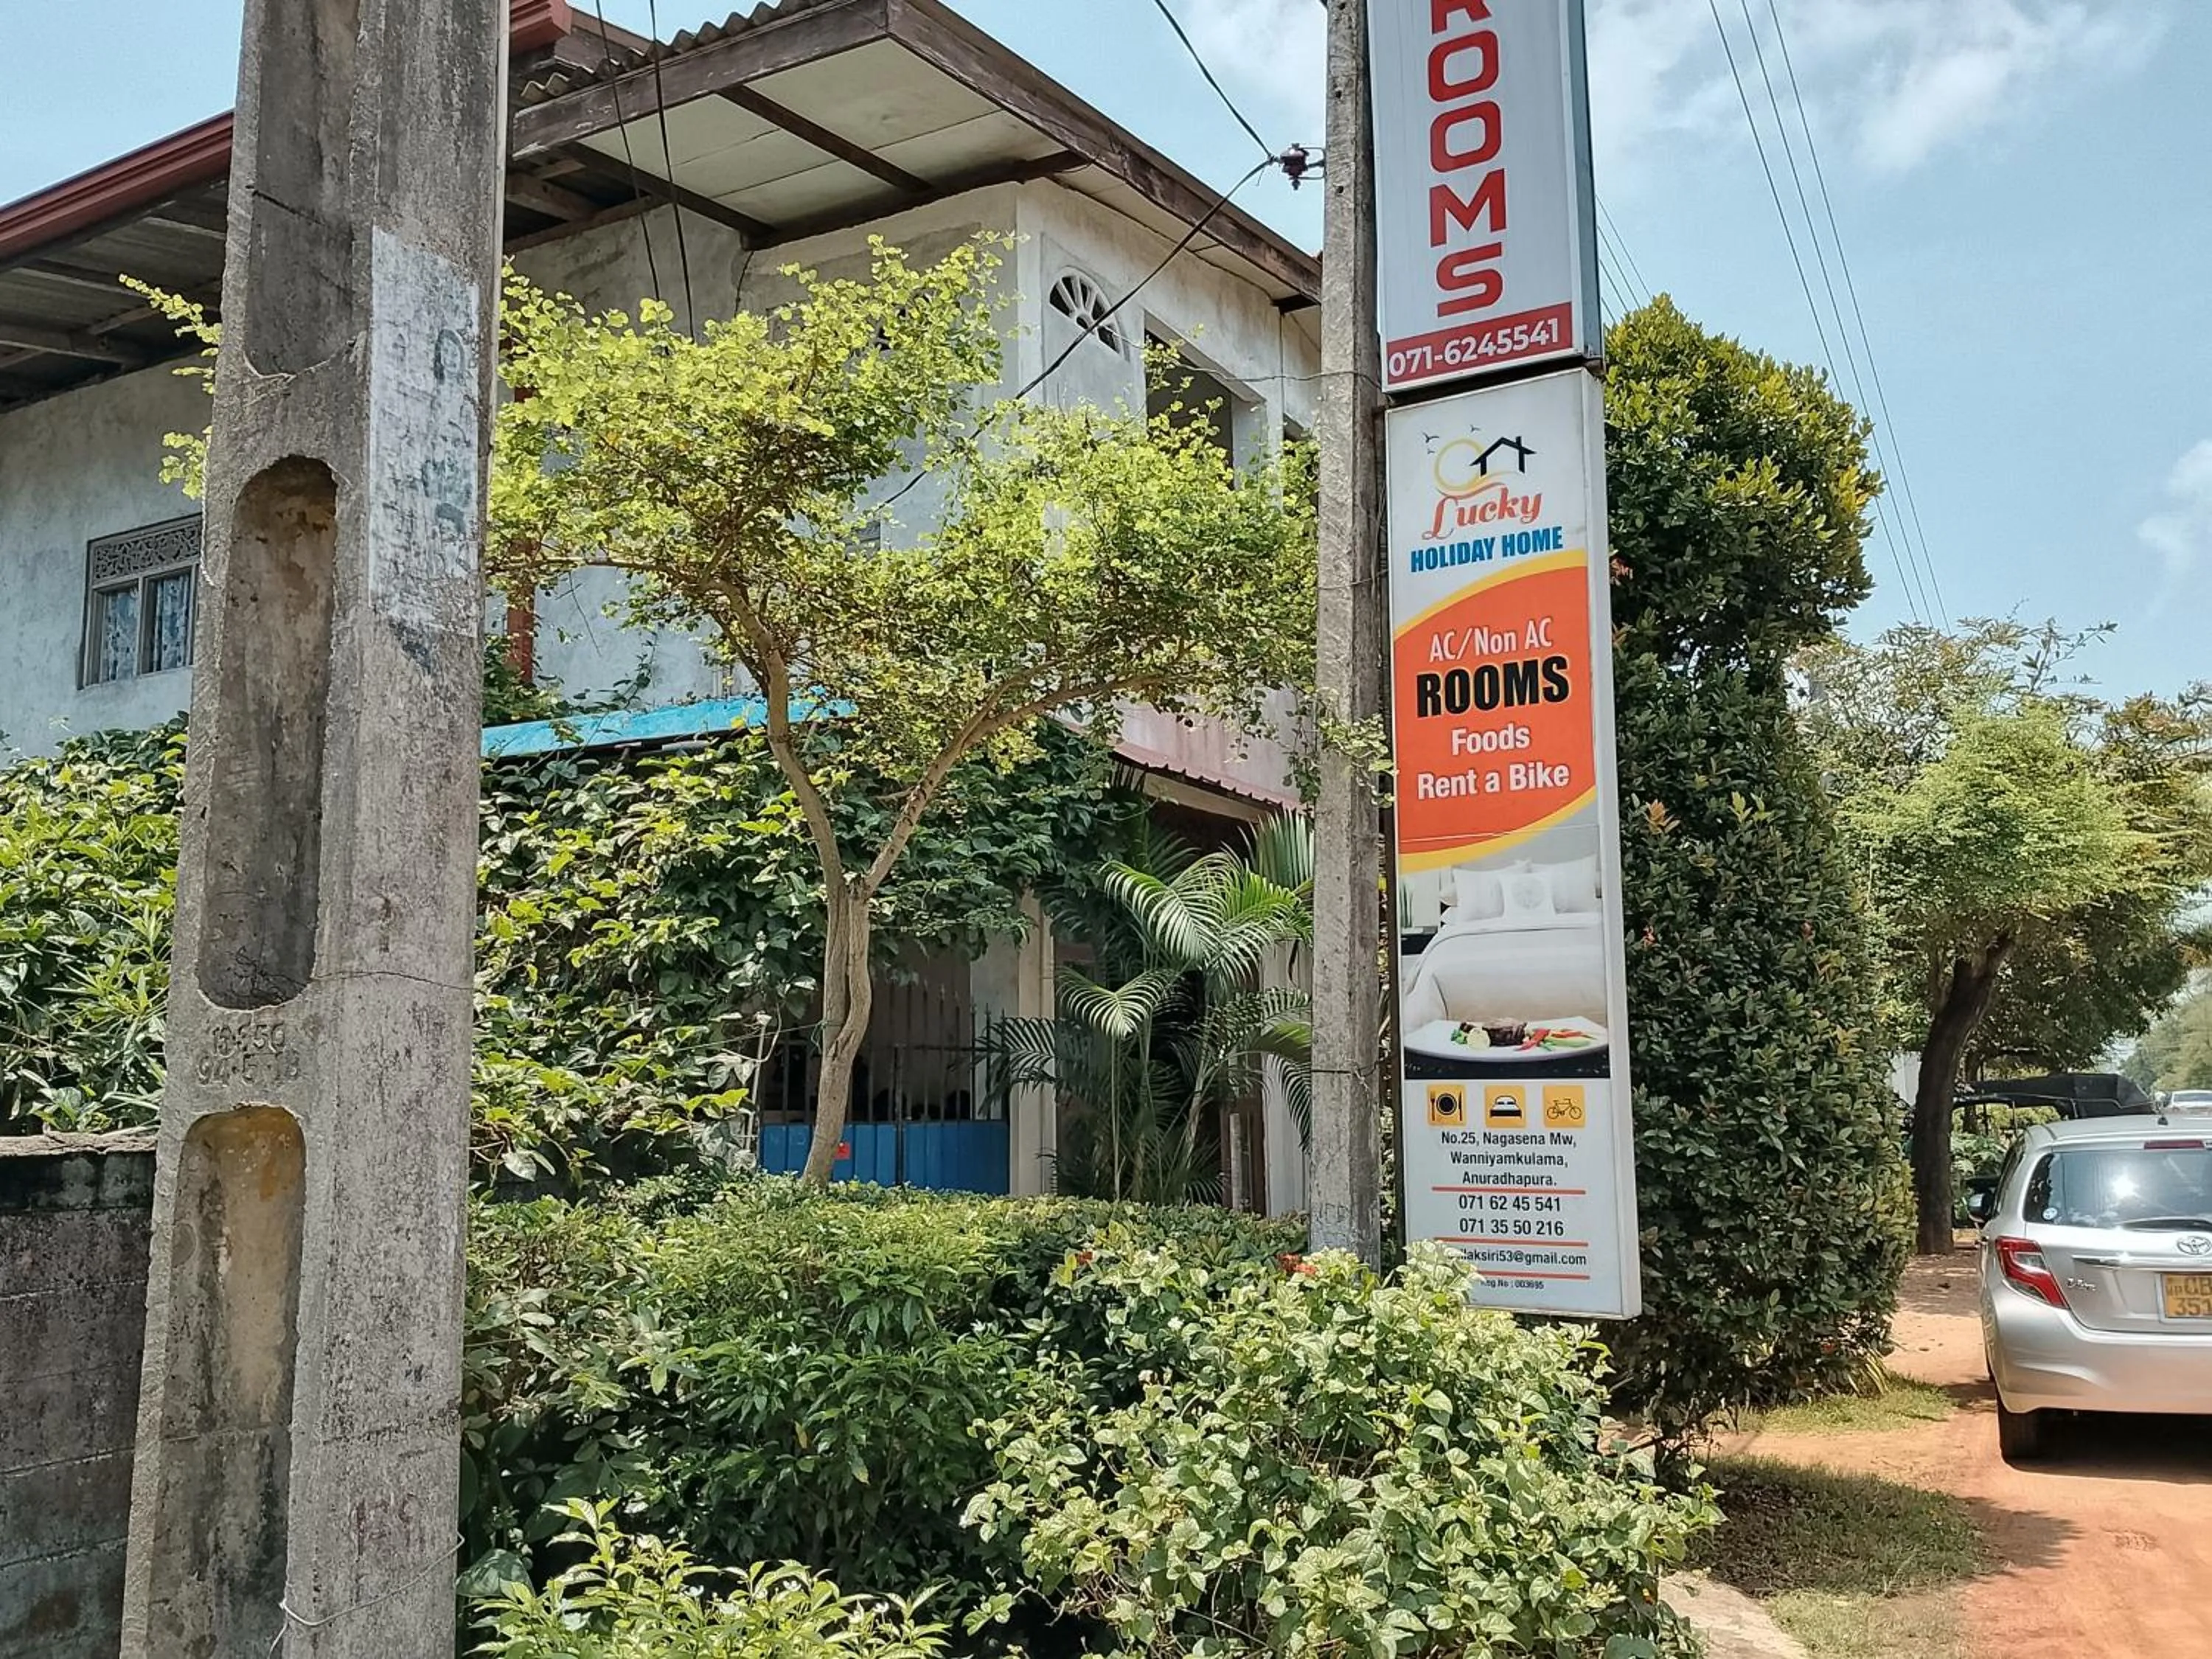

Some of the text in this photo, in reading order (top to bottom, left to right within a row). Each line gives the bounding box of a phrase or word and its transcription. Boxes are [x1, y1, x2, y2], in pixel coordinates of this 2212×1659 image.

[1388, 319, 1558, 377] 071-6245541
[1422, 487, 1542, 540] Lucky
[1411, 526, 1563, 572] HOLIDAY HOME
[1429, 616, 1553, 662] AC/Non AC
[1416, 655, 1570, 718] ROOMS
[1451, 723, 1531, 756] Foods
[1417, 762, 1570, 801] Rent a Bike
[1441, 1132, 1577, 1147] No.25, Nagasena Mw,
[1450, 1152, 1568, 1168] Wanniyamkulama,
[1462, 1171, 1557, 1187] Anuradhapura.
[1458, 1194, 1561, 1212] 071 62 45 541
[1459, 1217, 1564, 1236] 071 35 50 216
